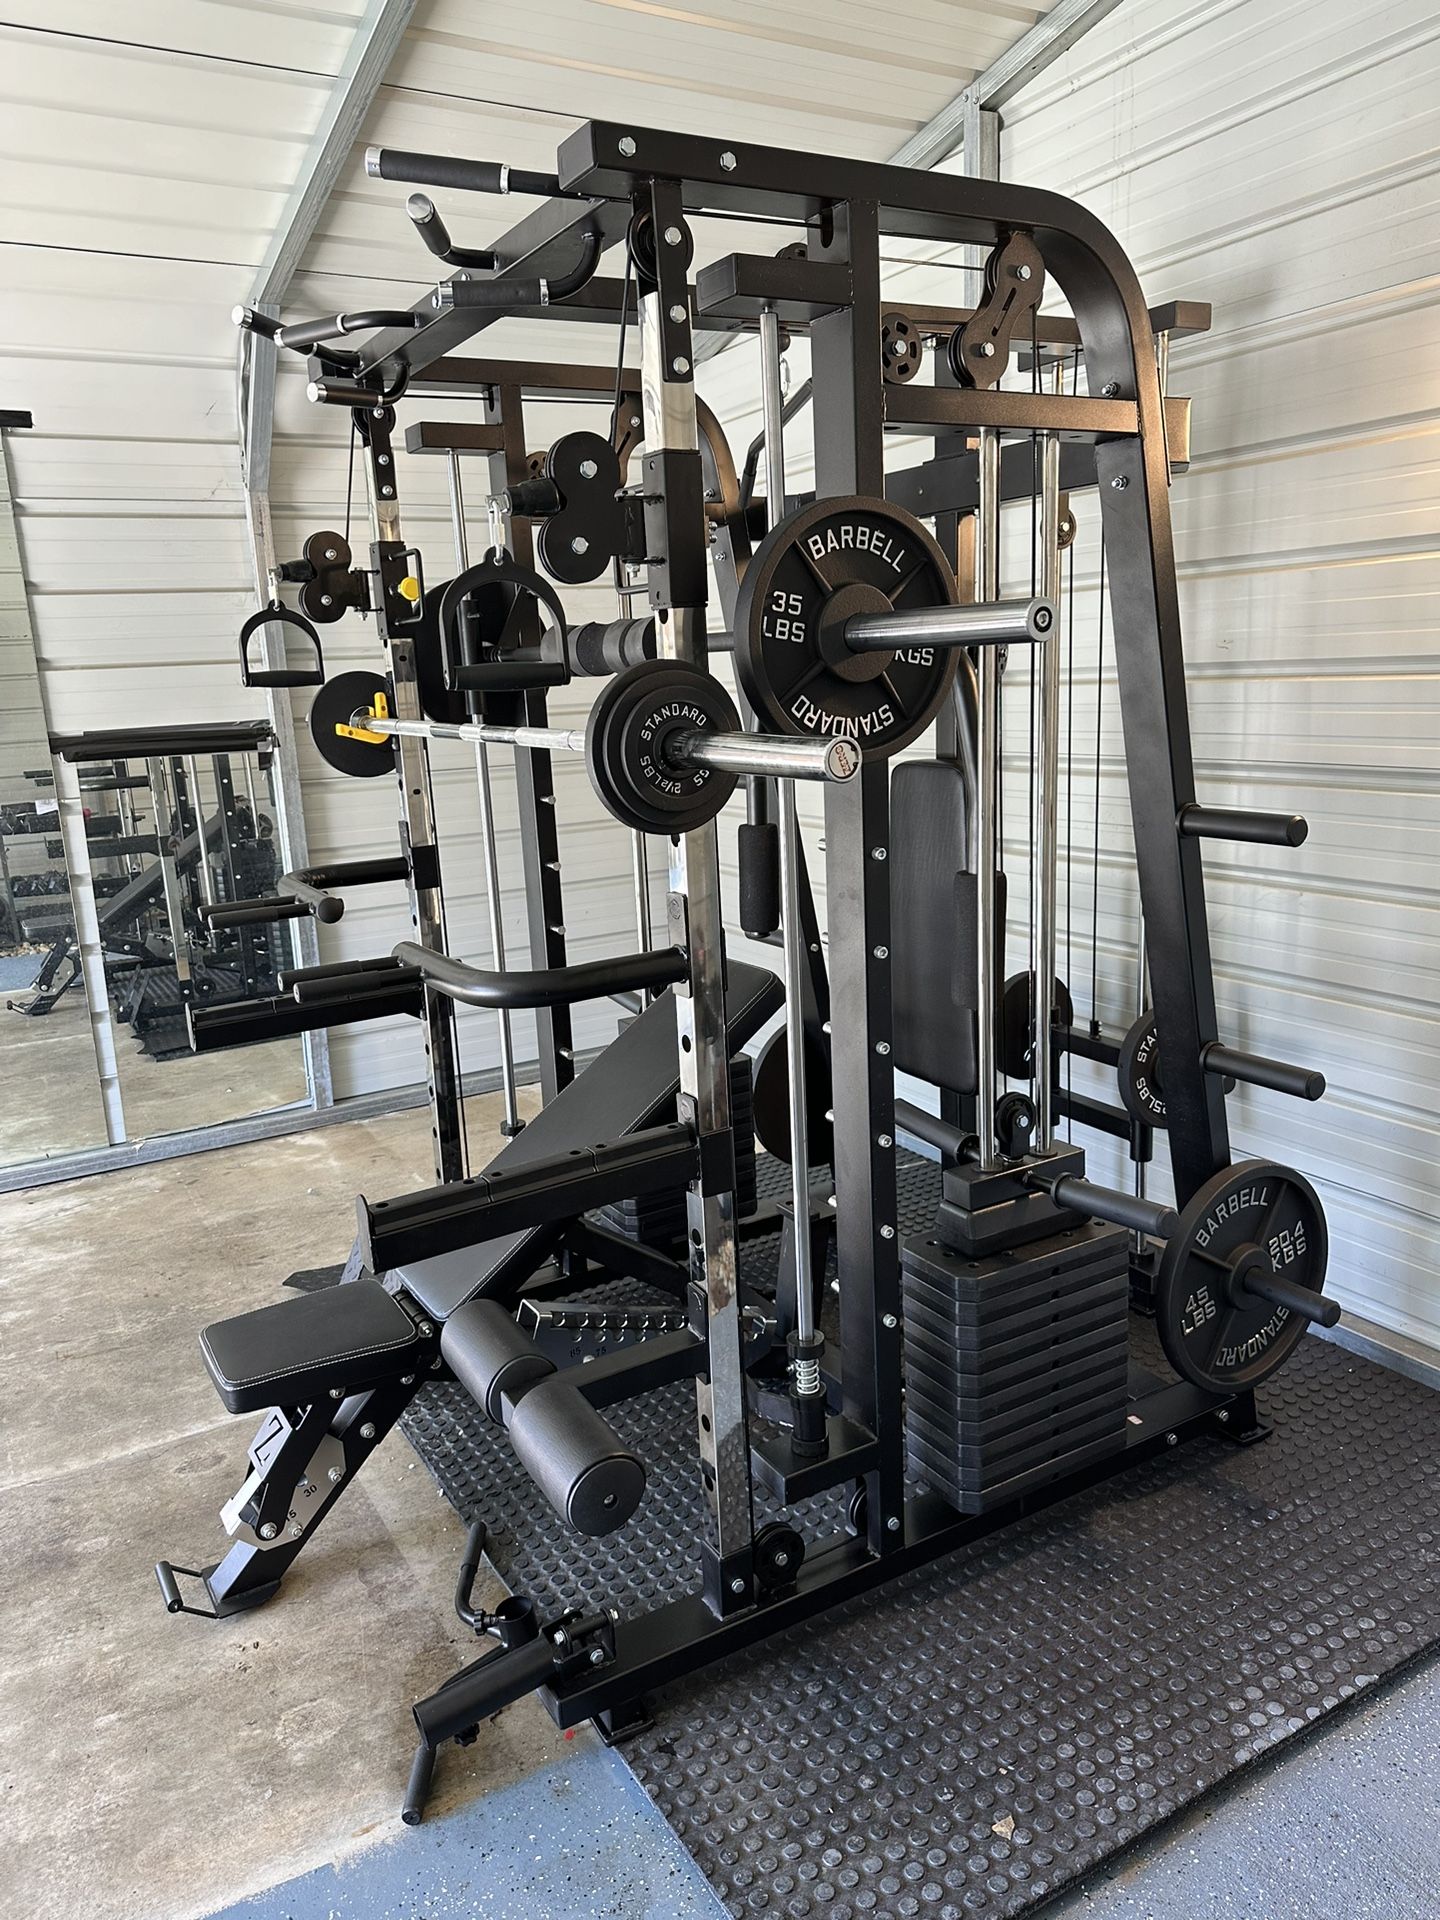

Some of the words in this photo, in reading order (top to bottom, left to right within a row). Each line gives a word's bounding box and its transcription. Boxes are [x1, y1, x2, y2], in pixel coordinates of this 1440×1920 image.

[808, 525, 906, 572] BARBELL
[771, 590, 803, 615] 35
[762, 615, 805, 643] LBS
[641, 703, 707, 741] STANDARD
[791, 695, 895, 738] STANDARD
[693, 768, 710, 787] GS
[1195, 1186, 1269, 1248] BARBELL
[1268, 1220, 1305, 1255] 20.4
[1271, 1236, 1307, 1273] KGS
[1181, 1299, 1217, 1336] LBS
[1185, 1285, 1209, 1314] 45
[1216, 1305, 1290, 1367] STANDARD
[303, 1484, 318, 1498] 30
